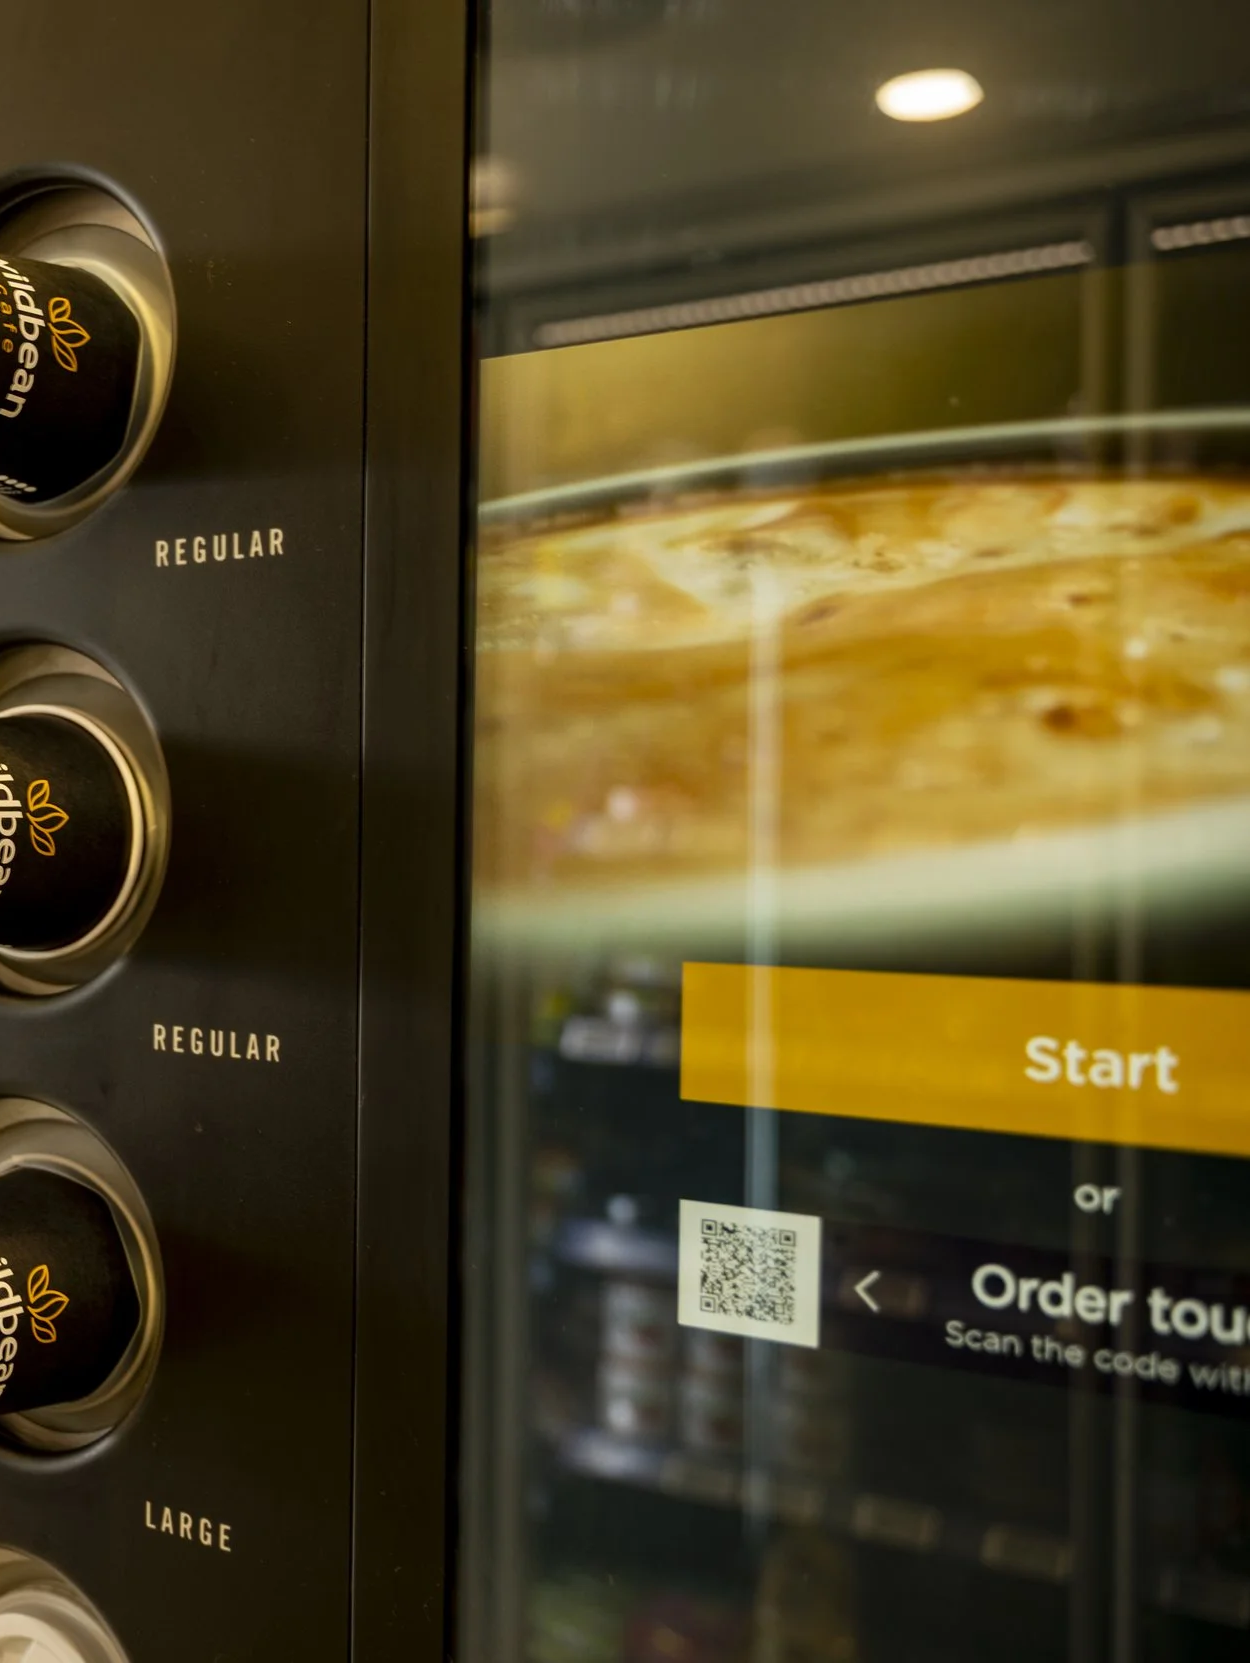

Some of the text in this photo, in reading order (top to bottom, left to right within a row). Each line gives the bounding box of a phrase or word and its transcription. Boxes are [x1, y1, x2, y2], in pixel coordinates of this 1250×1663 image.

[155, 528, 285, 568] REGULAR
[153, 1023, 281, 1063] REGULAR
[1023, 1035, 1179, 1094] Start
[1073, 1183, 1122, 1214] or
[971, 1263, 1250, 1345] Order tou
[945, 1320, 1023, 1357] Scan
[1030, 1335, 1085, 1367] the
[1093, 1349, 1180, 1385] code
[144, 1500, 232, 1553] LARGE
